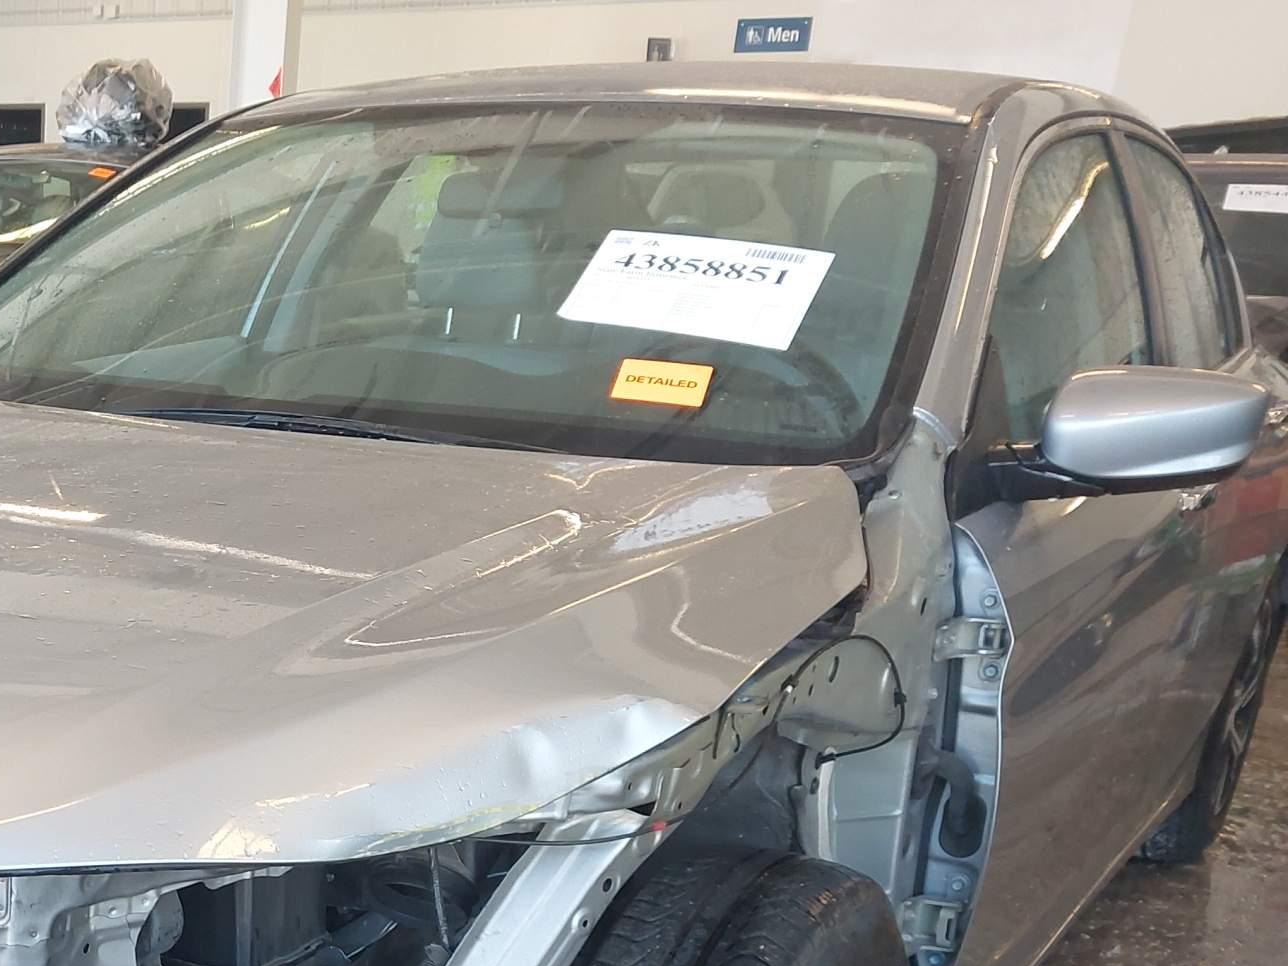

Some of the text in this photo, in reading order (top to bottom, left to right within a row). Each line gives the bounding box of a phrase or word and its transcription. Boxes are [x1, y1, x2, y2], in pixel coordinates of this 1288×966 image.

[767, 26, 800, 43] Men
[615, 252, 790, 285] 43858851
[624, 374, 699, 389] DETAILED
